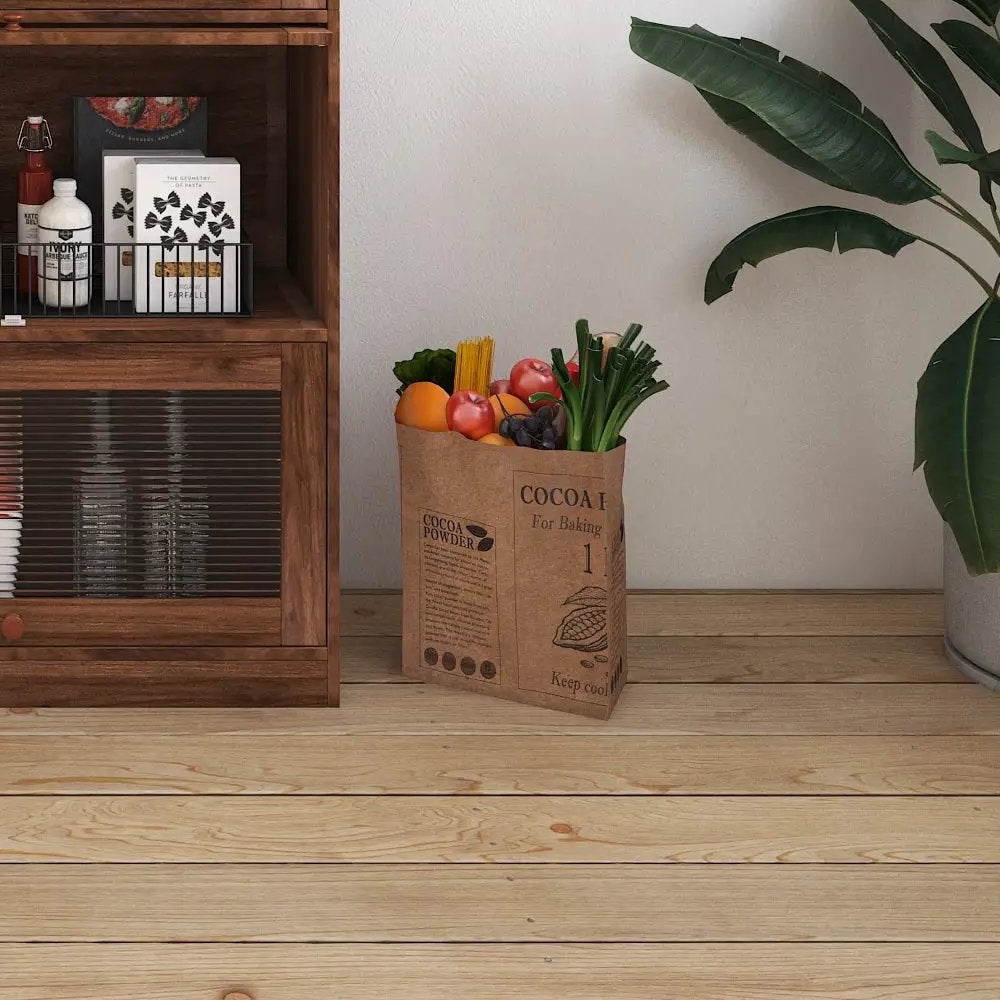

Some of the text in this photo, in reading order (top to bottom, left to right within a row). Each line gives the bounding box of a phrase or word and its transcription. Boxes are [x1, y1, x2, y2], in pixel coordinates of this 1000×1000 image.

[520, 484, 593, 509] COCOA
[423, 513, 463, 535] COCOA
[531, 514, 602, 537] For Baking
[423, 526, 475, 551] POWDER
[551, 670, 581, 695] Keep
